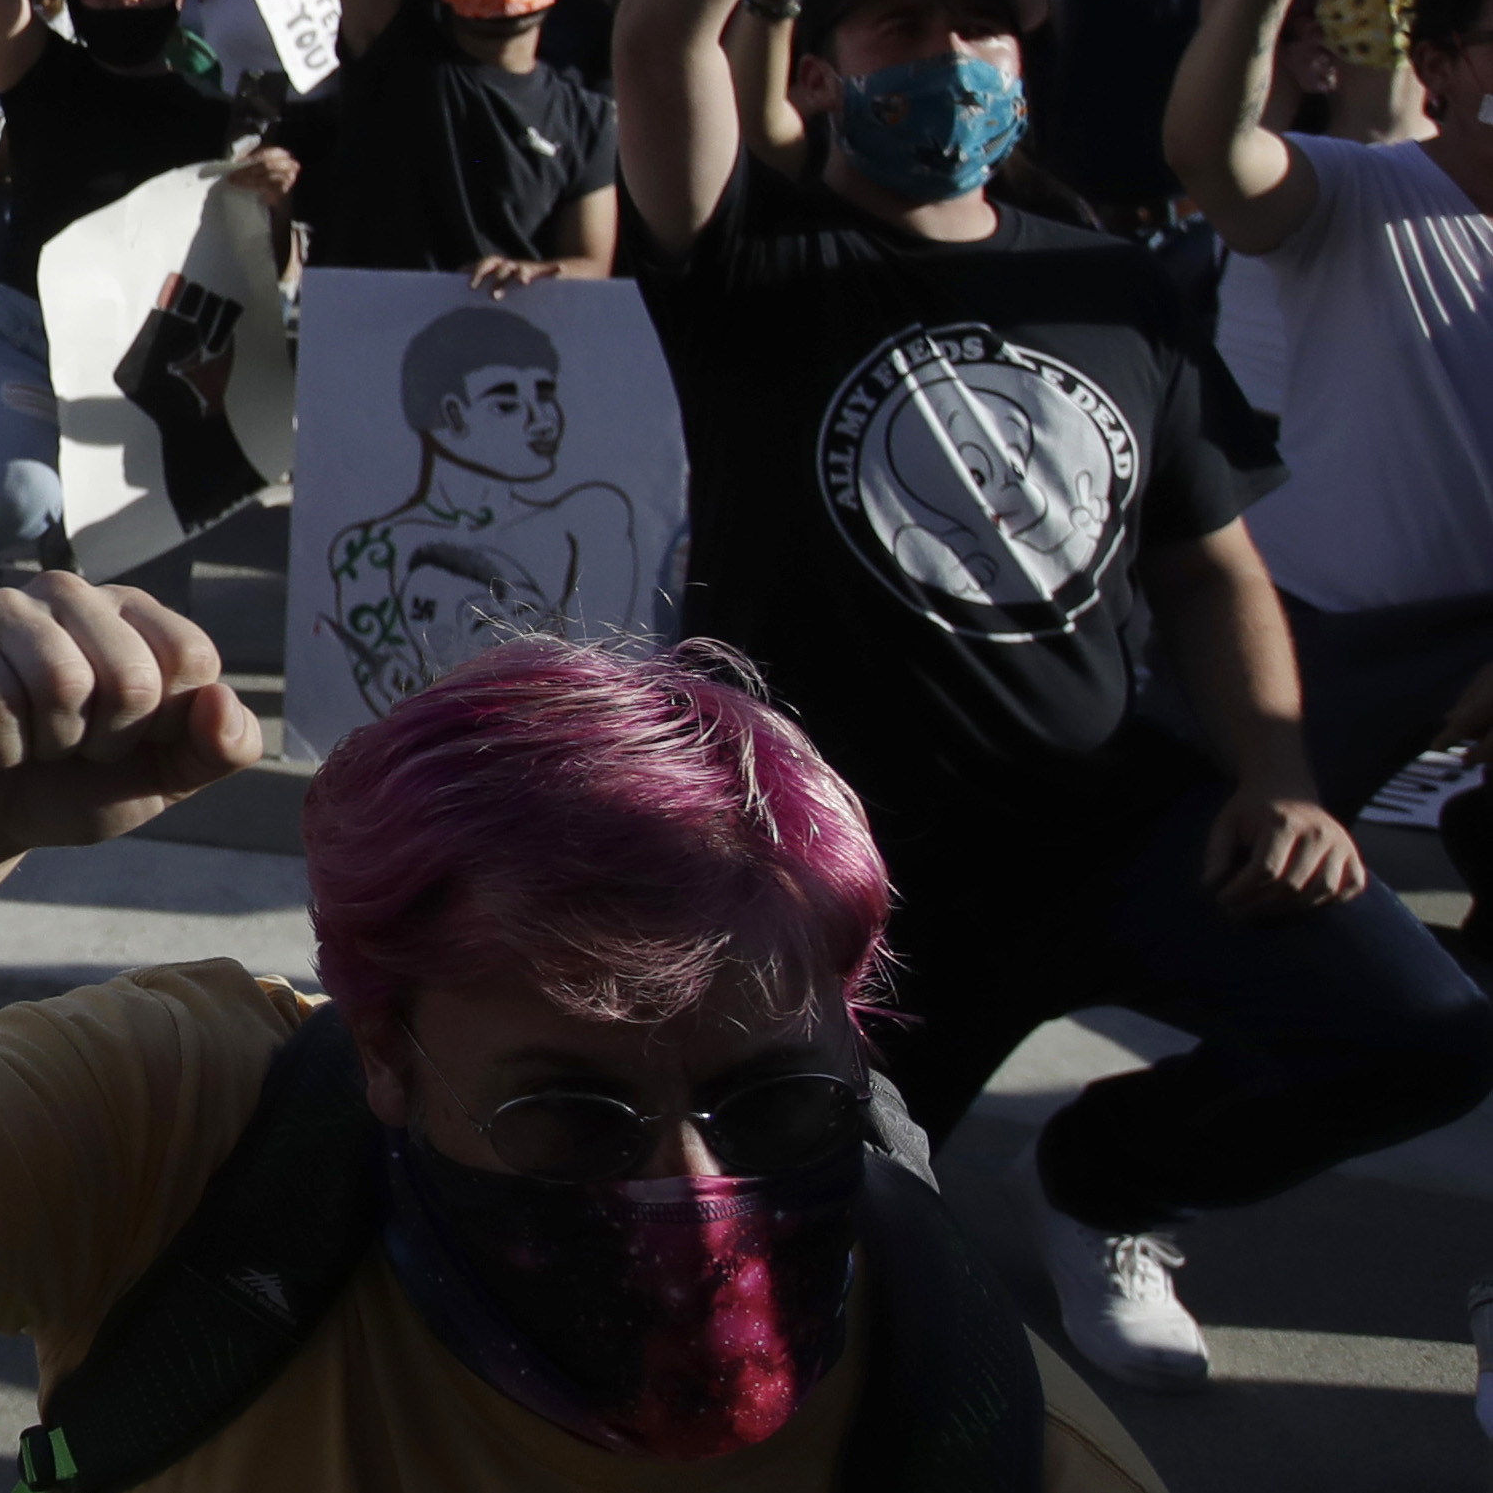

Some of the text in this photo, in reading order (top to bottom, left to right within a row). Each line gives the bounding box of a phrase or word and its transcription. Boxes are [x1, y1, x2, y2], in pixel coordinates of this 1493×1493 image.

[834, 386, 879, 443] MY
[1067, 382, 1132, 480] DEAD
[828, 446, 861, 512] ALL
